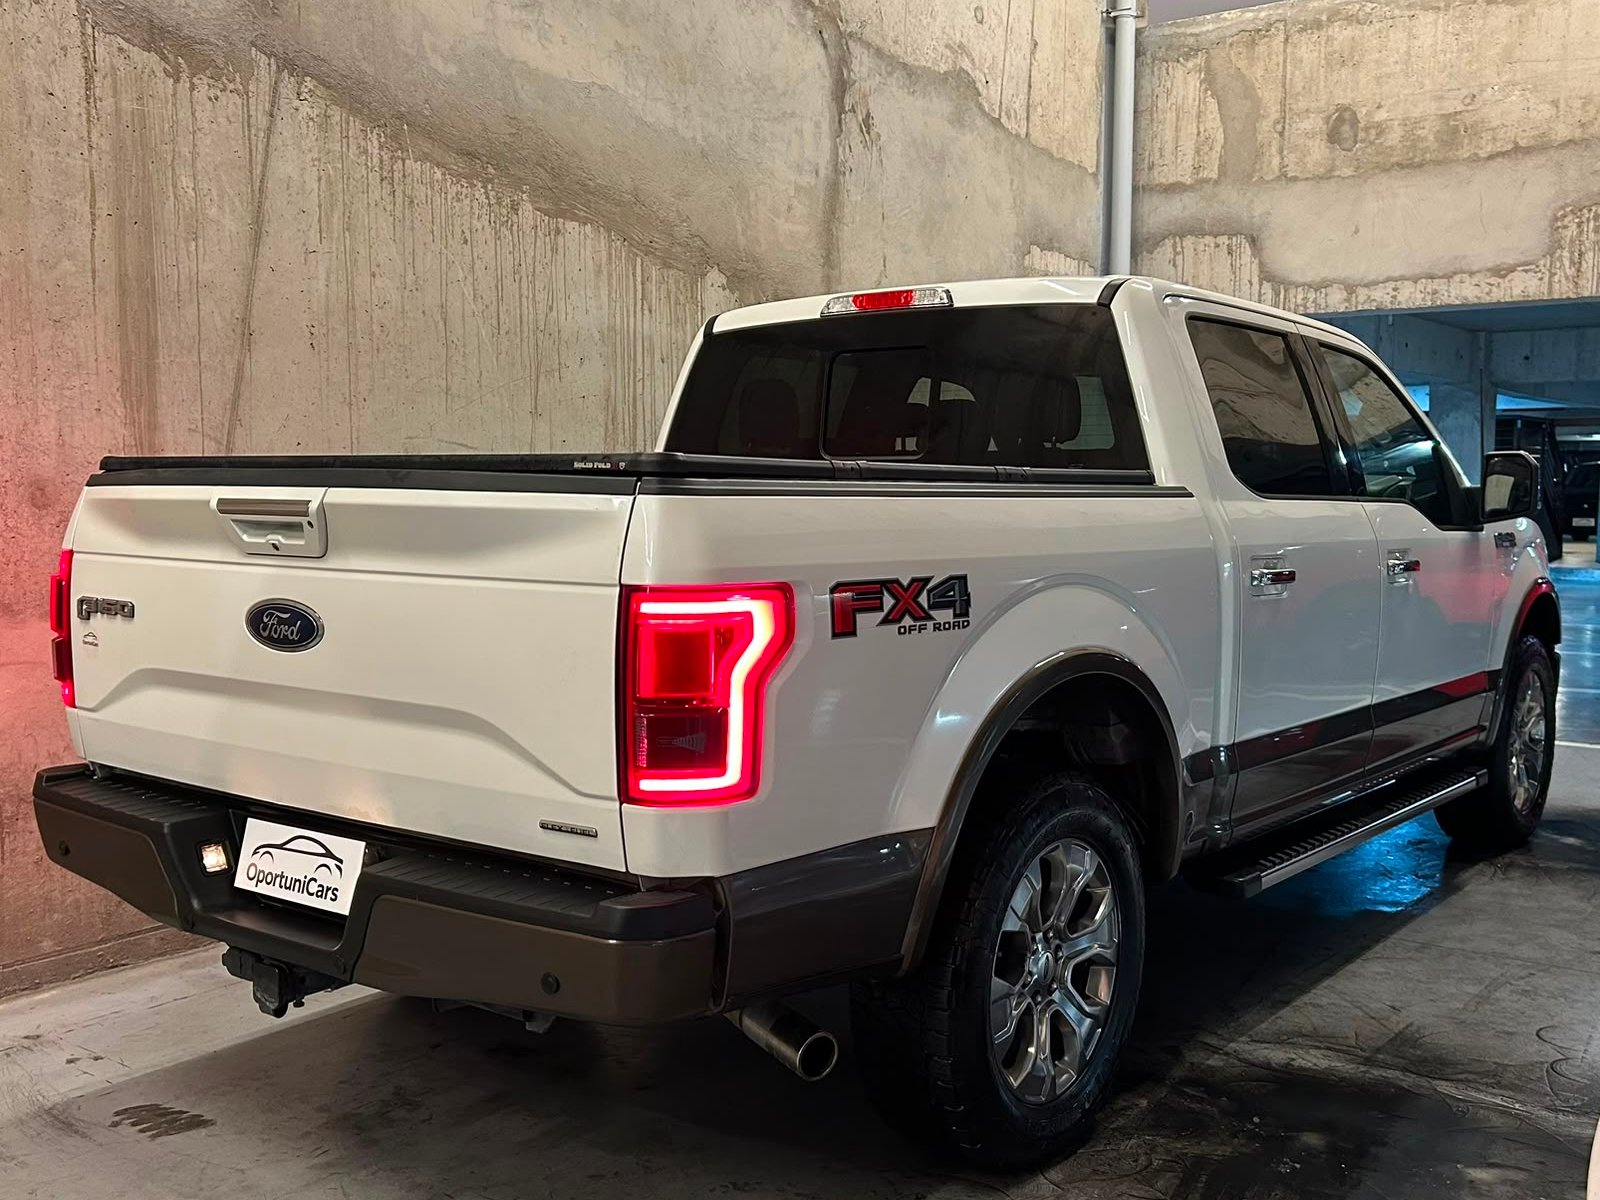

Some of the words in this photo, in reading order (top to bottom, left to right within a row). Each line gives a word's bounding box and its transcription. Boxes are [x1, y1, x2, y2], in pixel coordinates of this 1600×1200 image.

[829, 573, 971, 640] FX4
[259, 609, 302, 641] Ford
[897, 623, 928, 636] OFF
[932, 619, 971, 632] ROAD
[246, 862, 339, 902] OportuniCars
